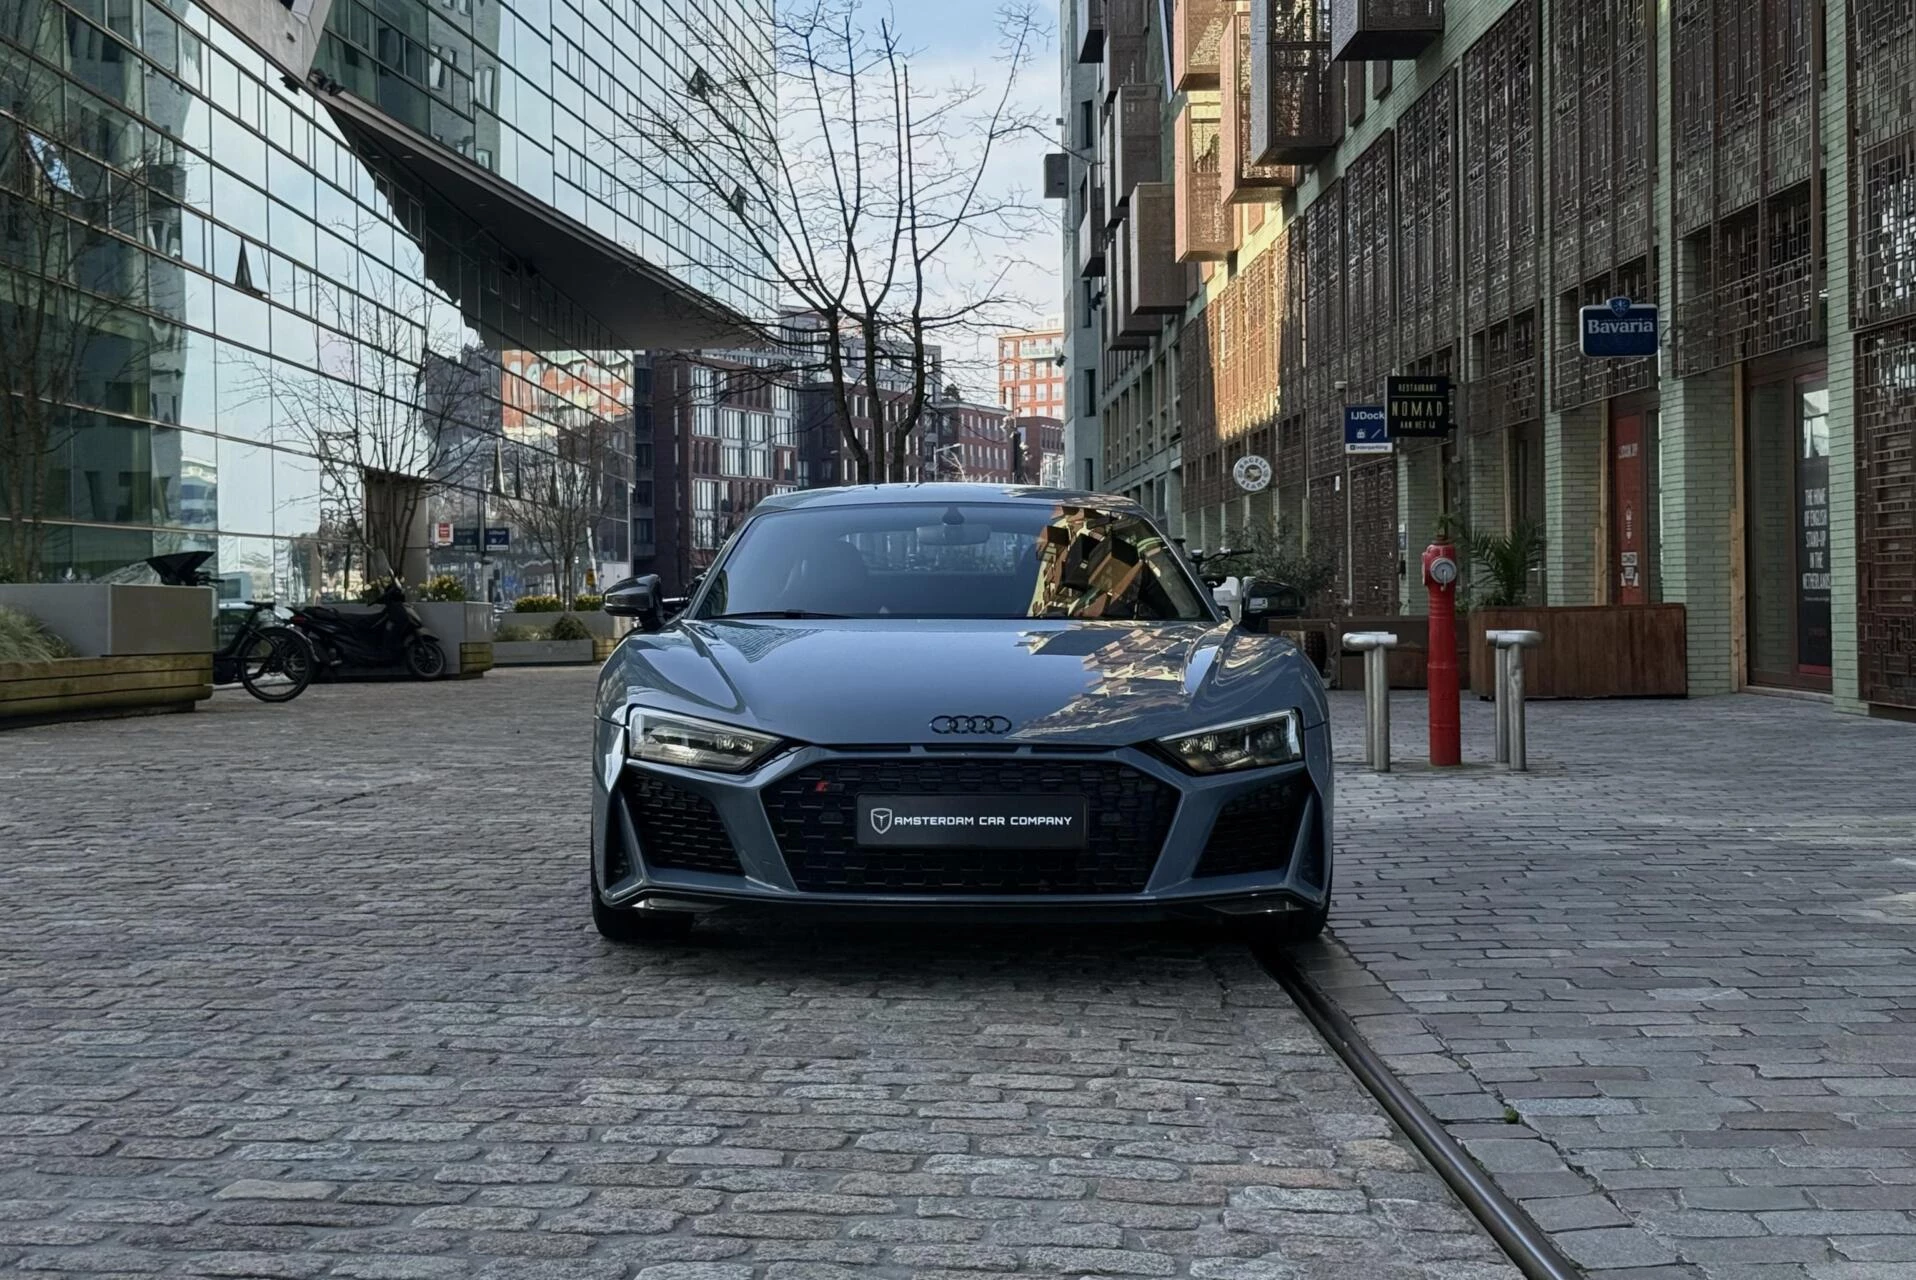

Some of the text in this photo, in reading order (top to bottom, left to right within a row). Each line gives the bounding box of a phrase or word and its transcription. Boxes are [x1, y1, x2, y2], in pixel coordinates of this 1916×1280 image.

[1587, 318, 1654, 334] Bavaria
[1398, 383, 1437, 392] RESTAURANT
[1350, 411, 1385, 420] IJDock
[1391, 400, 1443, 417] NOMAD
[1400, 420, 1412, 429] AAN
[1414, 420, 1426, 429] HET
[1804, 487, 1826, 505] THE HOME
[1810, 509, 1827, 526] ENGLISH
[1815, 551, 1824, 568] THE
[893, 816, 1073, 826] AMSTERDAM CAR COMPANY
